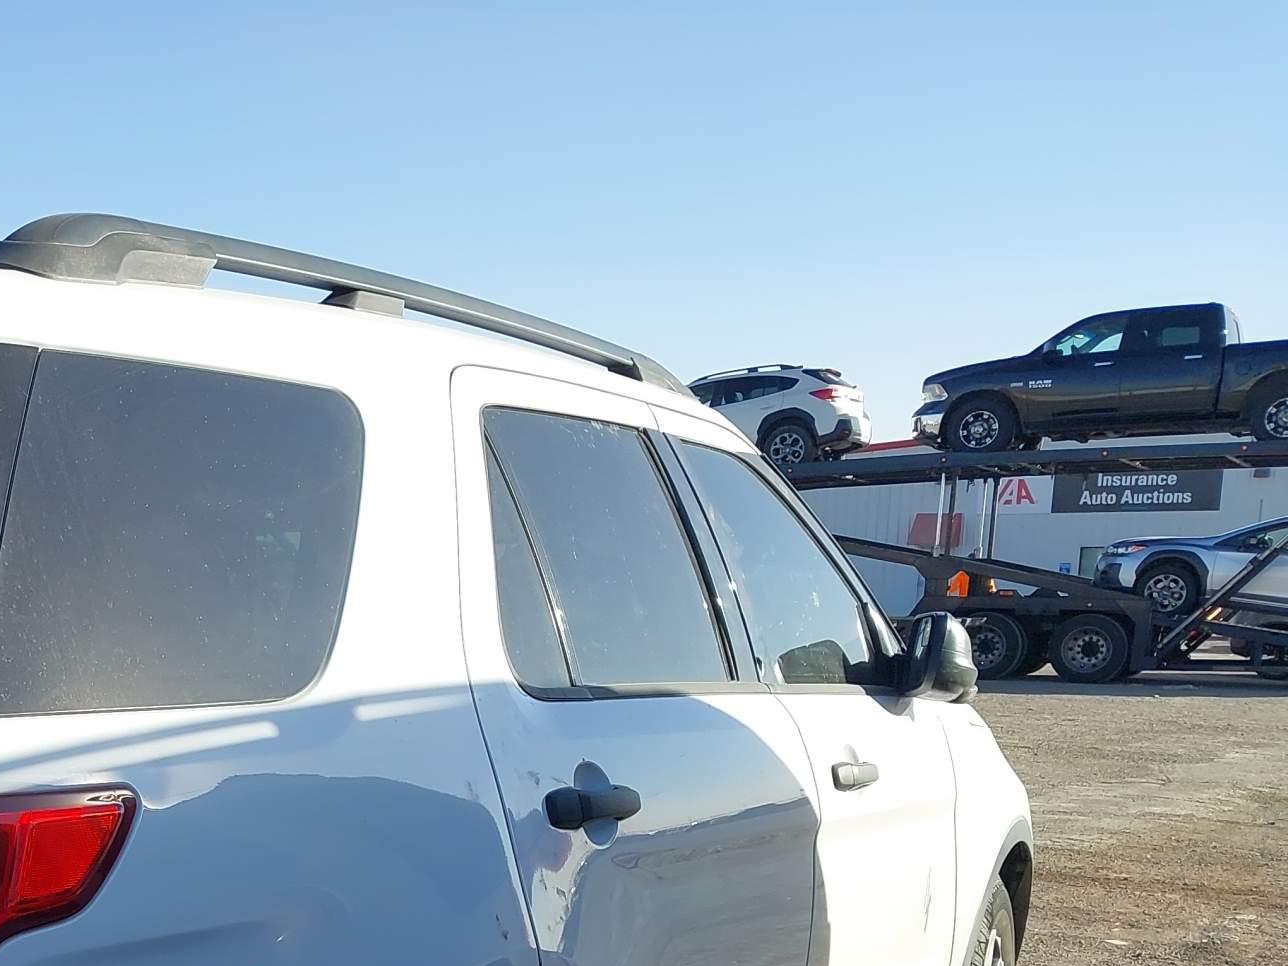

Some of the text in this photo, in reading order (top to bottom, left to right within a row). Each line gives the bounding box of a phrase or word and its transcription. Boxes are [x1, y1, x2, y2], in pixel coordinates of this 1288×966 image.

[1097, 472, 1177, 487] Insurance
[1079, 489, 1193, 505] Auto Auctions
